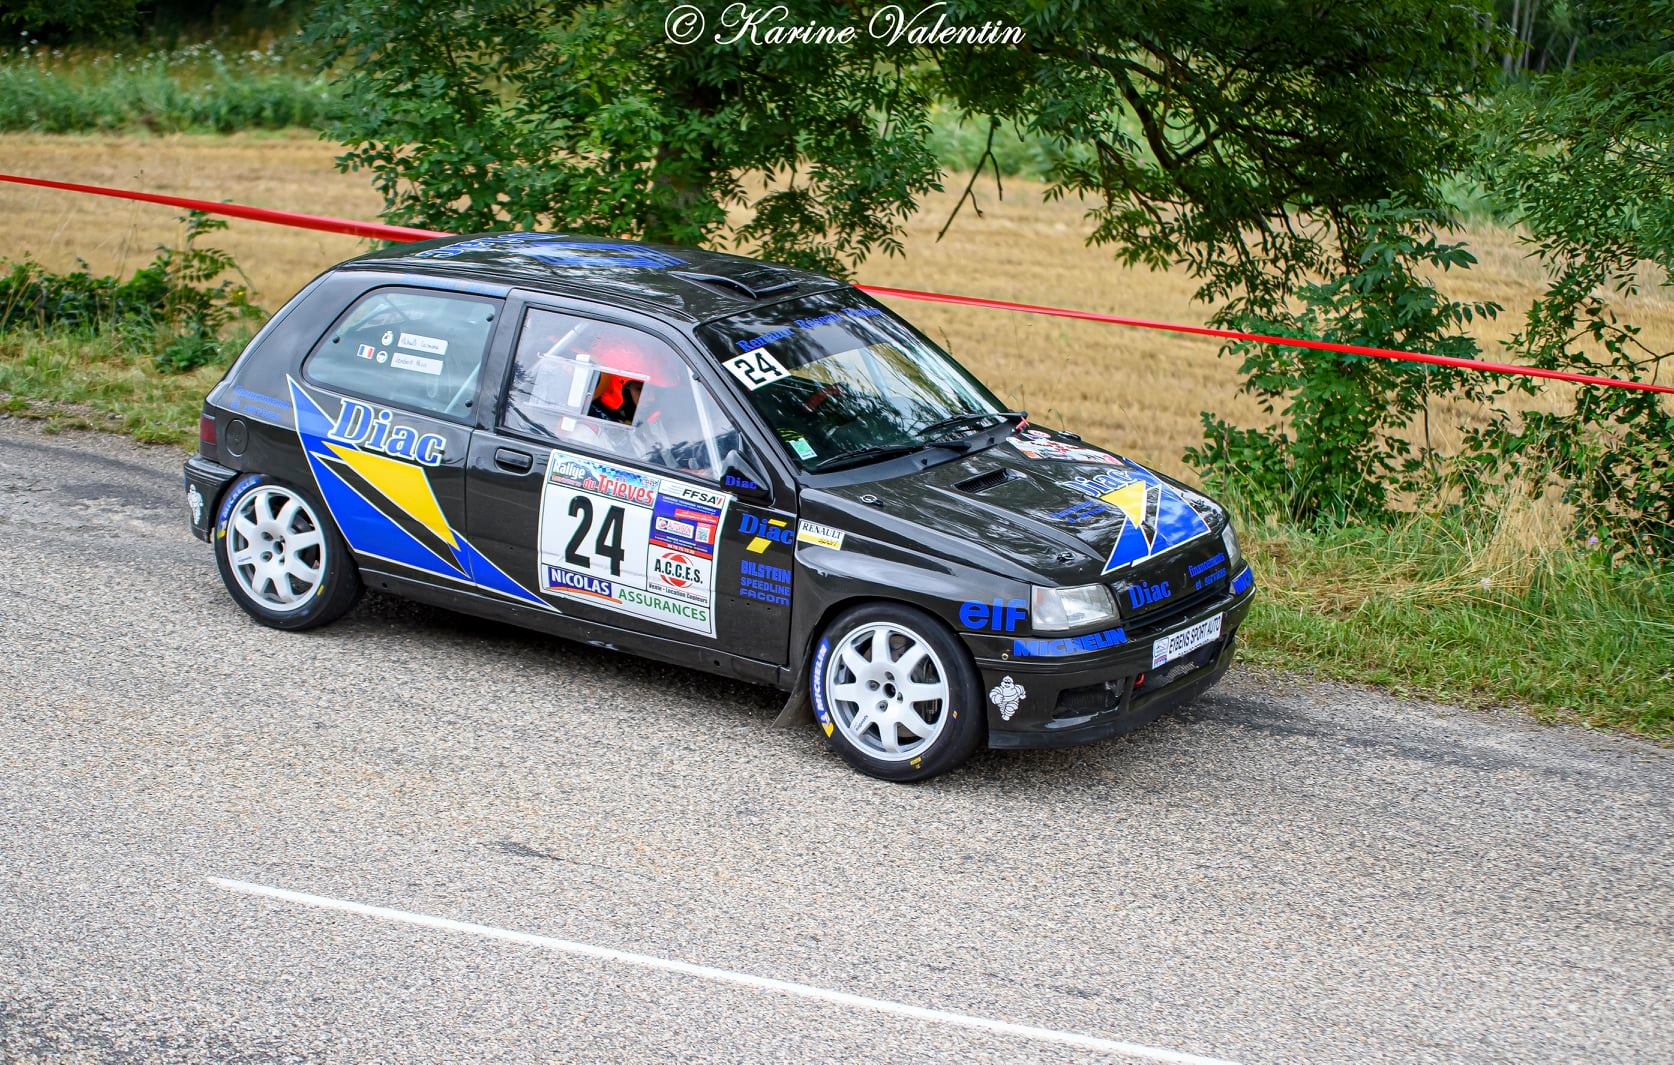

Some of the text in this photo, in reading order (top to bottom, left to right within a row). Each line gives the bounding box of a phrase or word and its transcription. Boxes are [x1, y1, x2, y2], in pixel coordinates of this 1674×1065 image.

[734, 352, 783, 385] 24
[328, 398, 447, 466] Diac
[553, 460, 587, 480] Rallye
[725, 475, 757, 489] Diac
[598, 474, 654, 505] Trièves
[682, 488, 717, 505] FFSA
[565, 495, 625, 577] 24
[738, 513, 795, 545] Diac
[802, 522, 842, 540] RENAULT
[654, 558, 703, 584] A.C.C.E.S.
[741, 560, 792, 584] BILSTEIN
[551, 568, 707, 622] NICOLAS ASSURANCES
[741, 577, 791, 597] SPEEDLINE
[1127, 580, 1172, 609] Diac
[959, 597, 1028, 632] elf
[1013, 626, 1128, 657] MICHELIN
[1168, 628, 1192, 655] EYBENS
[1190, 622, 1208, 645] SPORT
[1207, 615, 1221, 634] AUTO
[813, 643, 828, 713] MICHELIN
